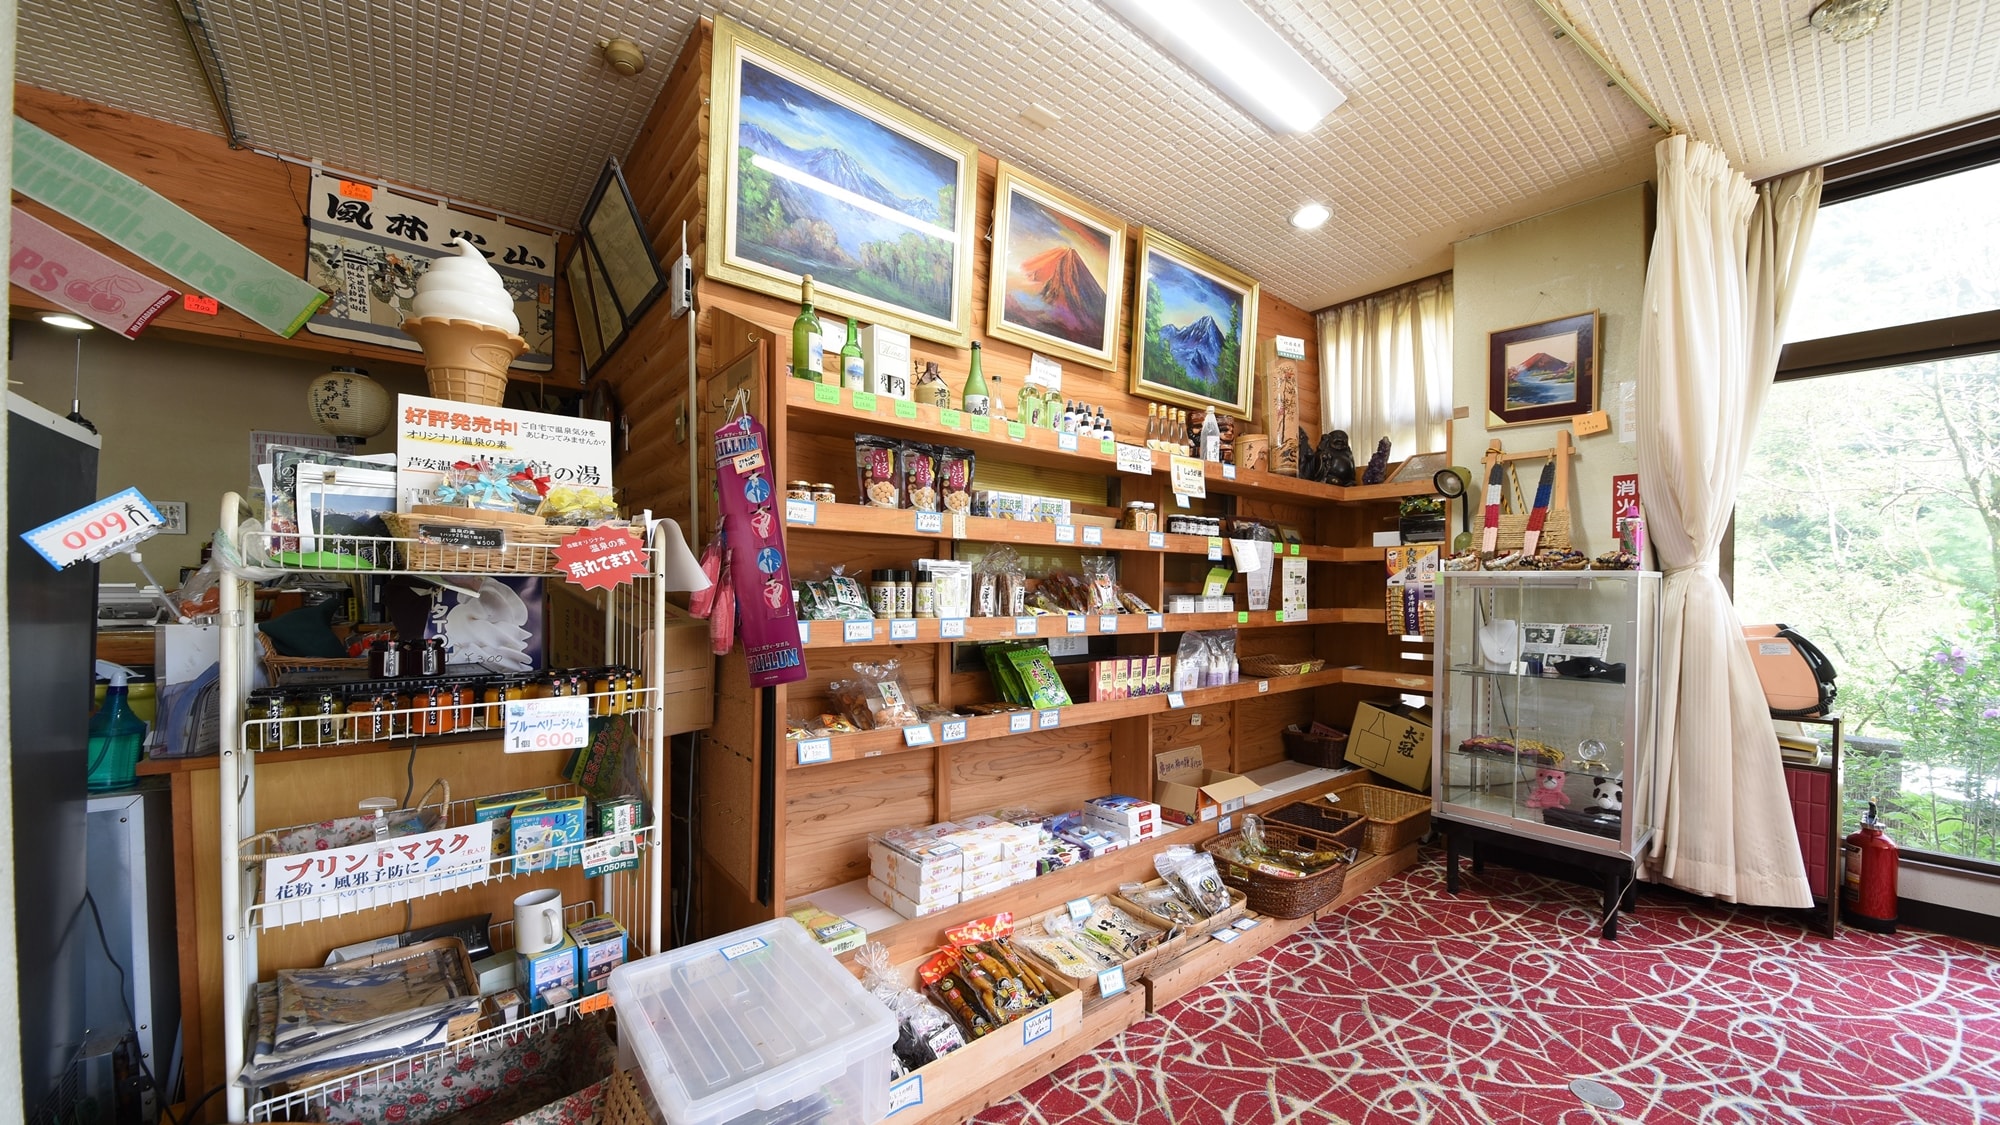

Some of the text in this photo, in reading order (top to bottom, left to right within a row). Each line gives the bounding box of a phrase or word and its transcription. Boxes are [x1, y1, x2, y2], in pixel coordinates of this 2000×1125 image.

[404, 406, 518, 436] 好評発売中!
[520, 421, 596, 438] ご自宅で温泉気分を
[406, 429, 508, 450] オリジナル温泉の素
[525, 430, 607, 447] あじわってみませんか?
[1000, 498, 1022, 510] 野沢菜
[1041, 502, 1063, 514] 野沢菜
[589, 537, 628, 553] 温泉の素
[568, 549, 639, 579] 売れてます!
[509, 718, 584, 735] ブルーベリージャム
[535, 731, 584, 748] 600円
[284, 833, 470, 884] プリントマスク
[597, 861, 627, 874] 1,050円
